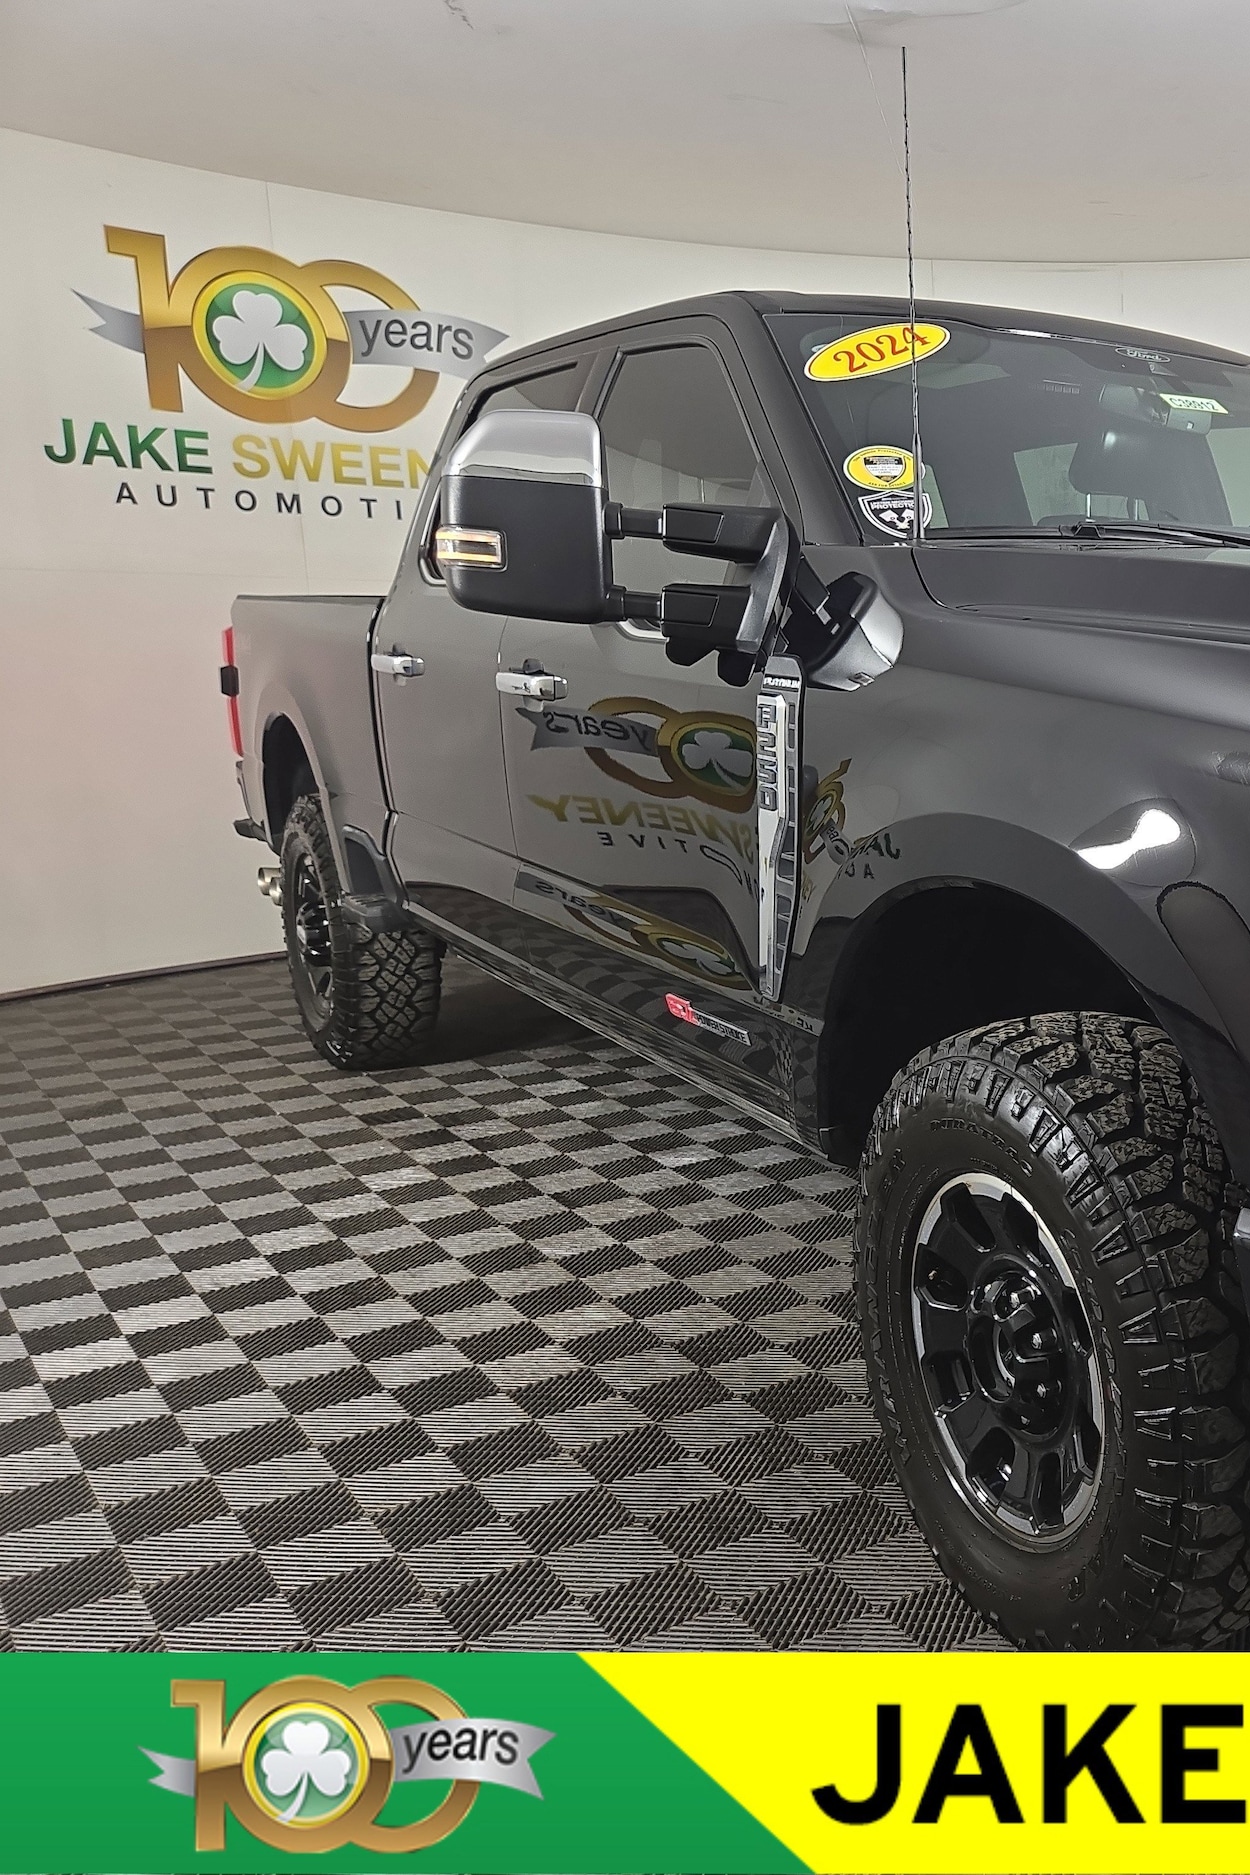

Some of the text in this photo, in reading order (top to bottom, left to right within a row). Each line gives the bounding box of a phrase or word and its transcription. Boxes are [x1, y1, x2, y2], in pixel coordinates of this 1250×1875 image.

[358, 317, 476, 360] years
[833, 327, 931, 373] 2024
[43, 417, 433, 491] JAKE SWEEN
[116, 481, 404, 520] AUTOMOTI
[871, 502, 914, 510] PROTECTIO
